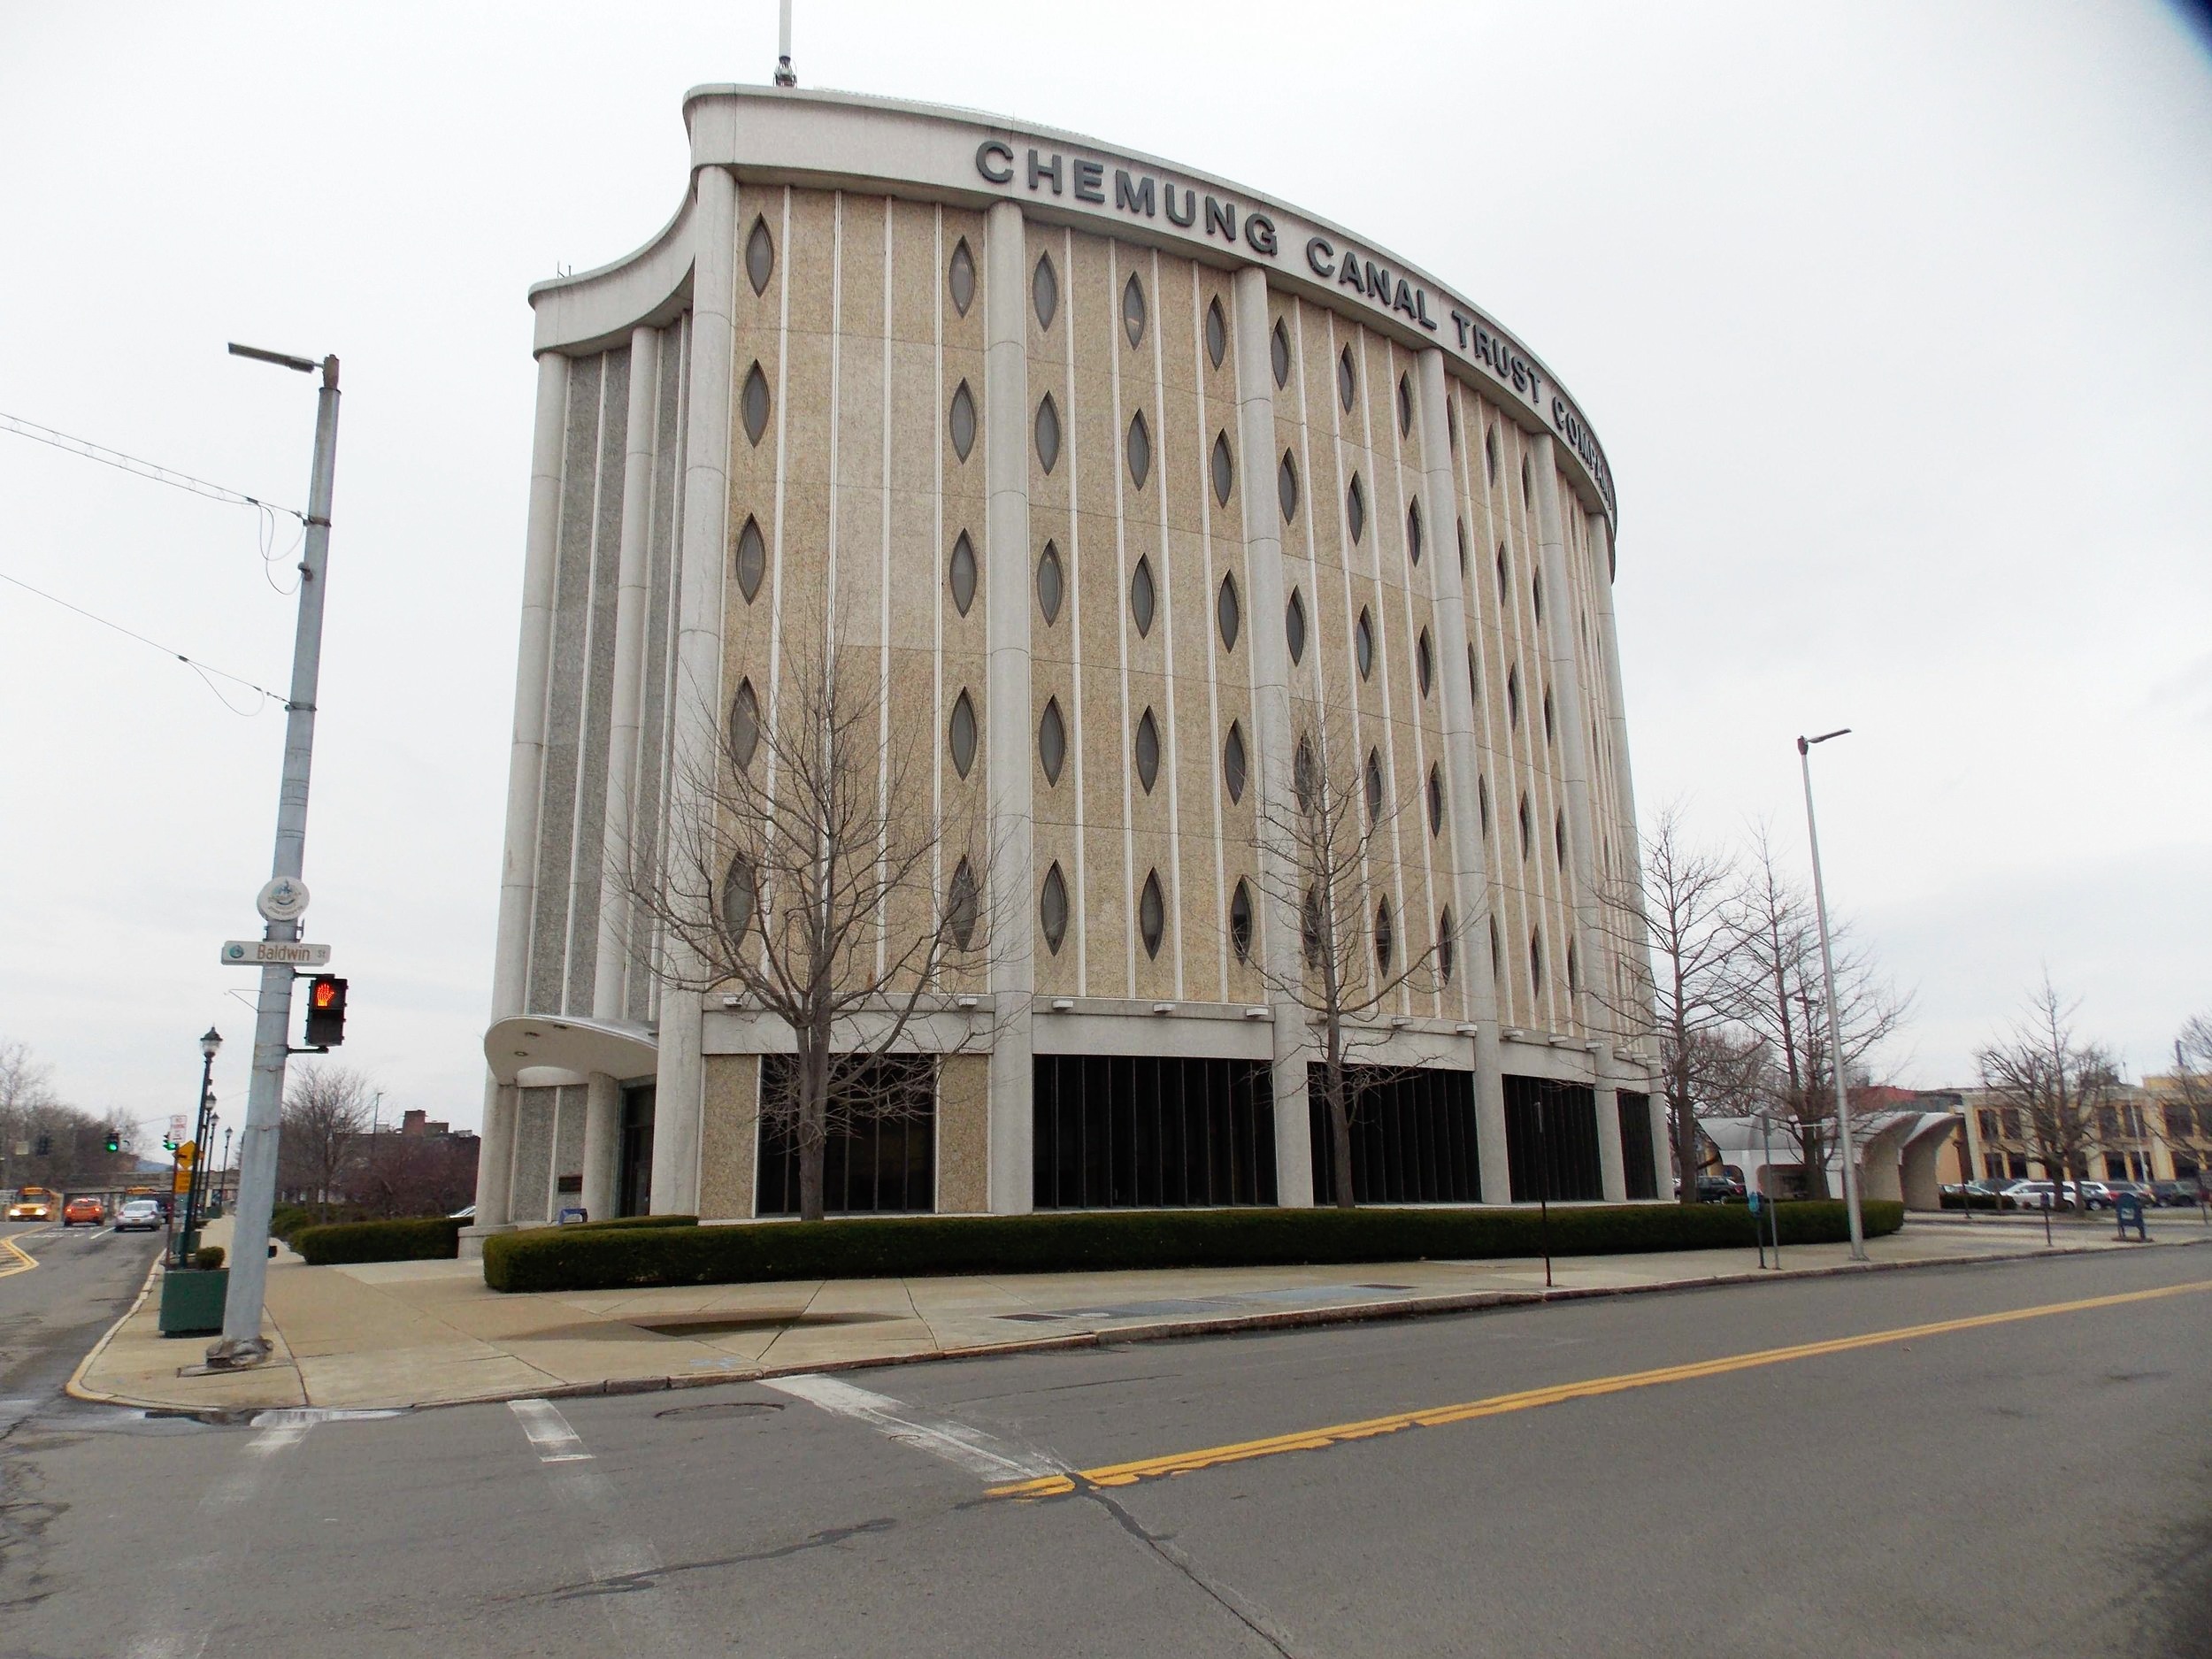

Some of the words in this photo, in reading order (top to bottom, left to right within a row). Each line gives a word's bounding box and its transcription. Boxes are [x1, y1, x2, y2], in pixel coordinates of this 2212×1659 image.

[975, 141, 1278, 256] CHEMUNG
[1306, 236, 1437, 330] CANAL
[1452, 310, 1540, 403] TRUST
[257, 944, 310, 961] Baldwin
